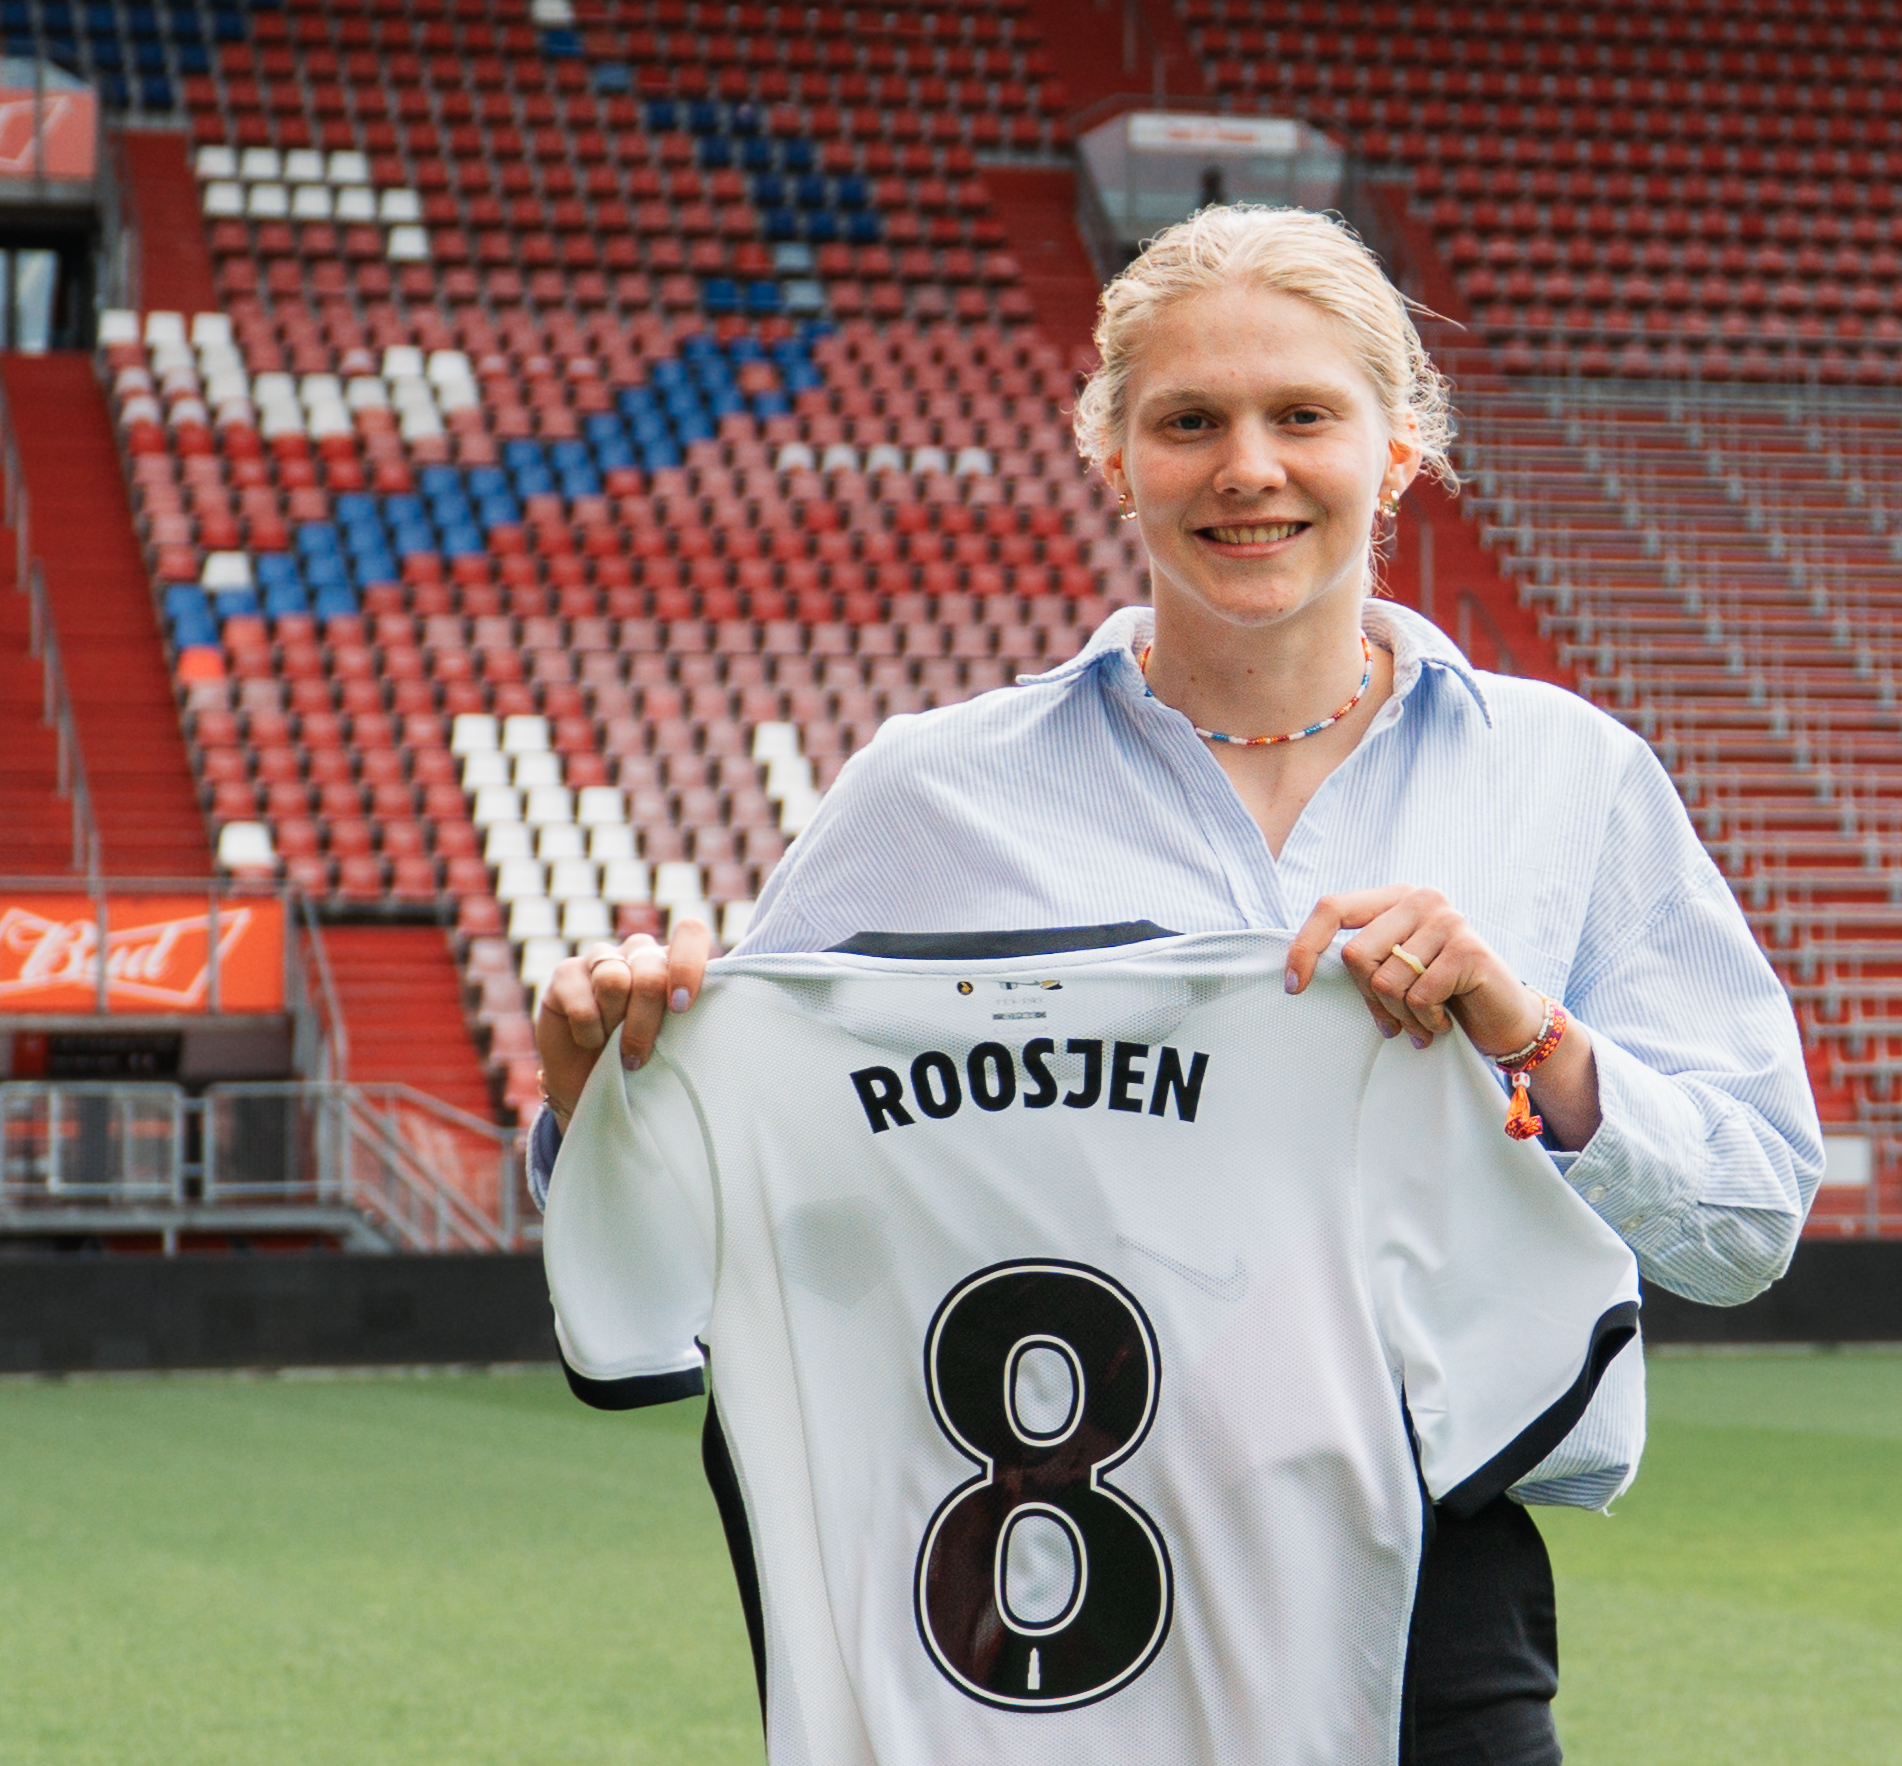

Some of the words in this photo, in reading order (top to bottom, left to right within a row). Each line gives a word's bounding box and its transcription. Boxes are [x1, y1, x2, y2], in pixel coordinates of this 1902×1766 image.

[5, 917, 176, 985] Bud
[850, 1037, 1210, 1134] ROOSJEN
[913, 1257, 1174, 1714] 8
